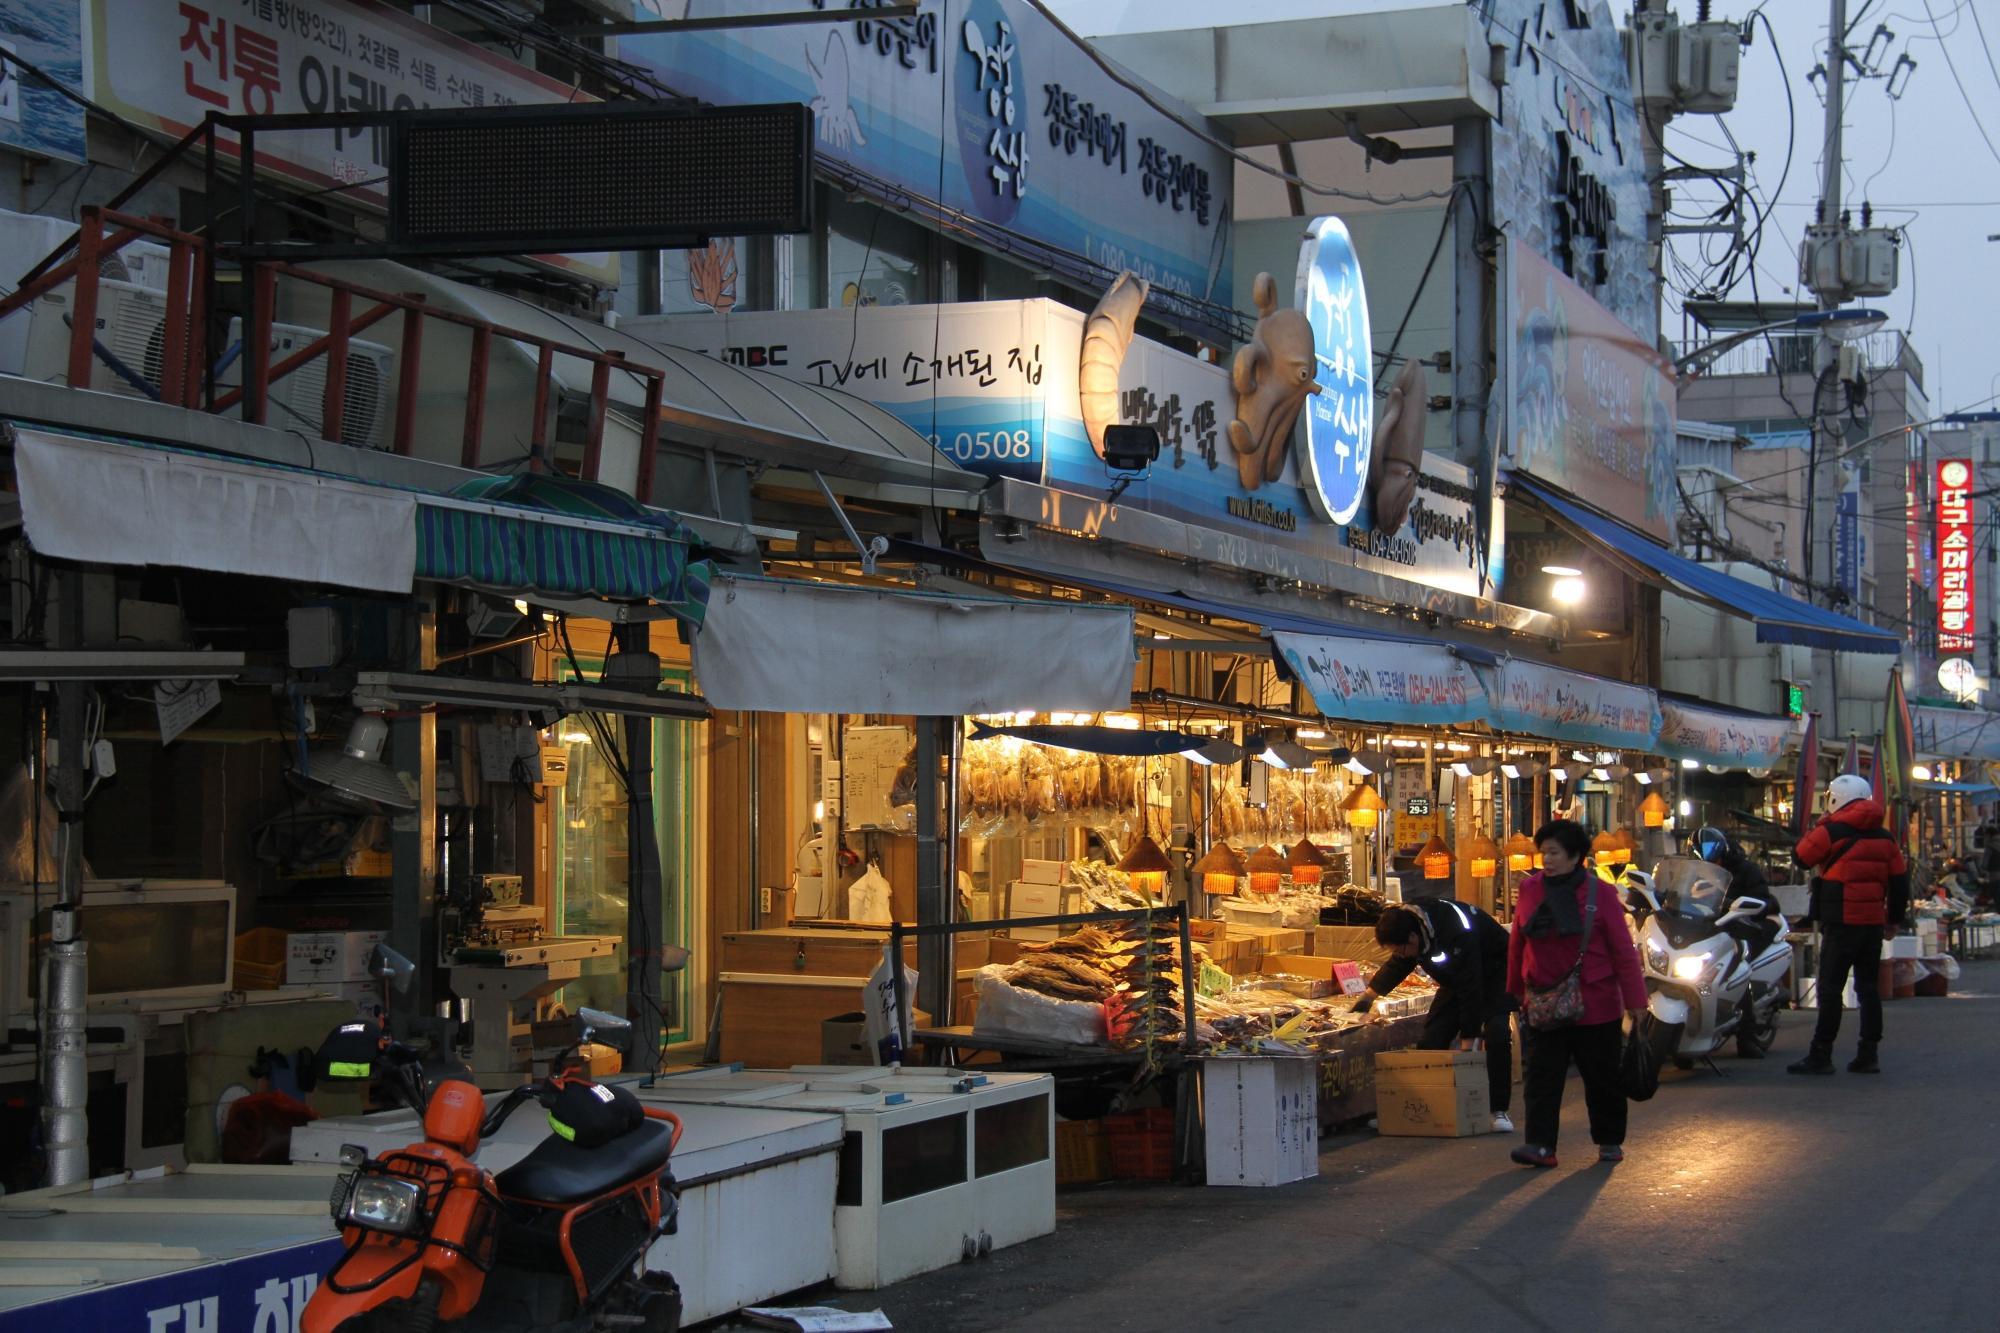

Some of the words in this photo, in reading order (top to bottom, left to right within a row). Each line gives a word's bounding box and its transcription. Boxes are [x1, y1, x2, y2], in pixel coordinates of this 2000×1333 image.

[180, 3, 281, 115] 전통
[1043, 83, 1127, 174] 경동과메기
[1138, 137, 1212, 226] 경동건어물
[721, 345, 788, 367] MBC
[806, 356, 887, 386] TV에
[902, 349, 998, 388] 소개된
[1007, 344, 1043, 386] 집
[1409, 806, 1428, 815] 29-3
